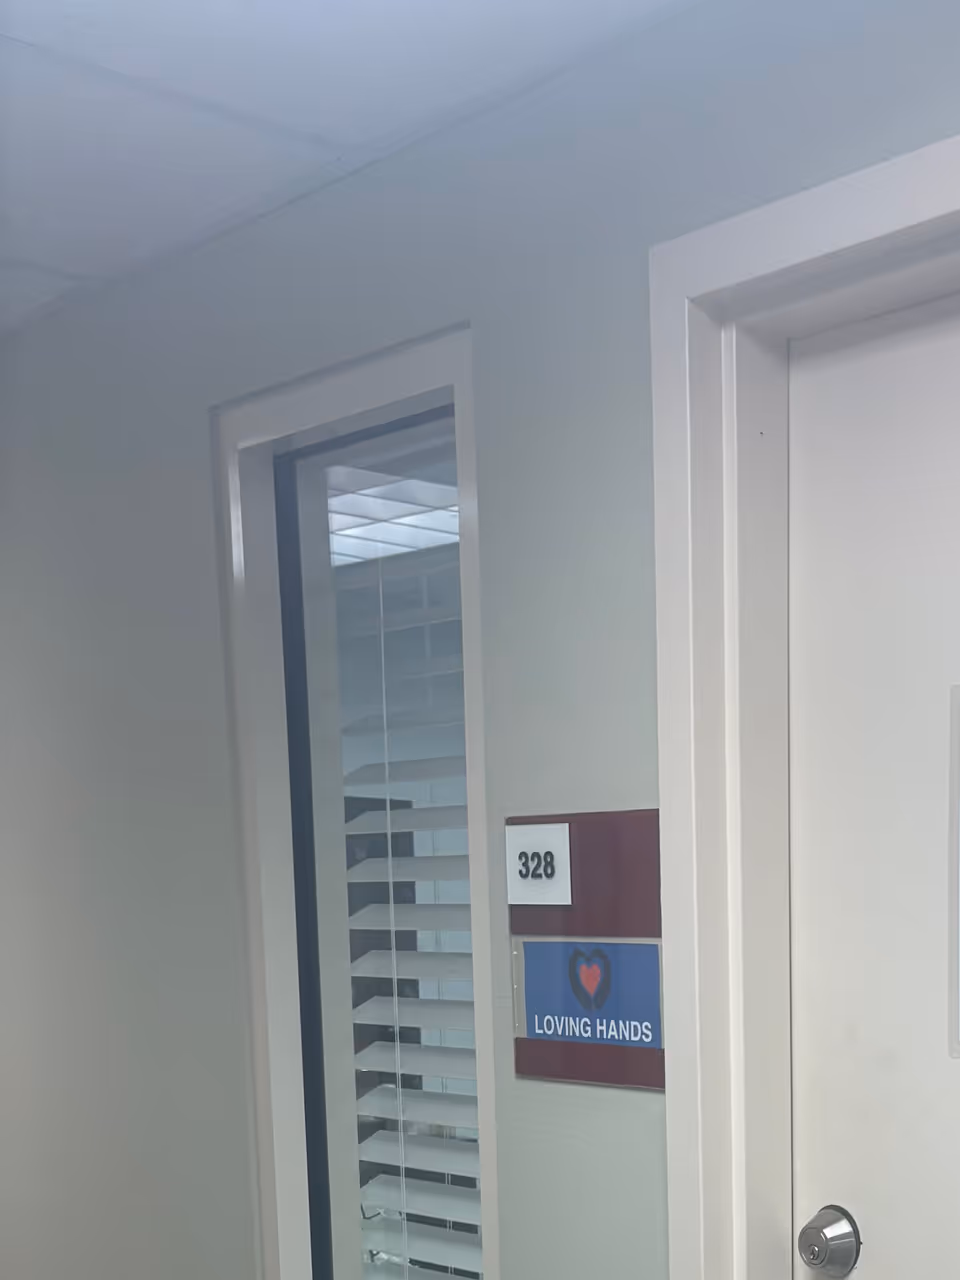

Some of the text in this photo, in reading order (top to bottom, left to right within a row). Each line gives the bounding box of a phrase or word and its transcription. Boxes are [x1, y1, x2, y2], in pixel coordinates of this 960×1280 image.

[518, 851, 556, 880] 328
[534, 1014, 653, 1043] LOVING HANDS
